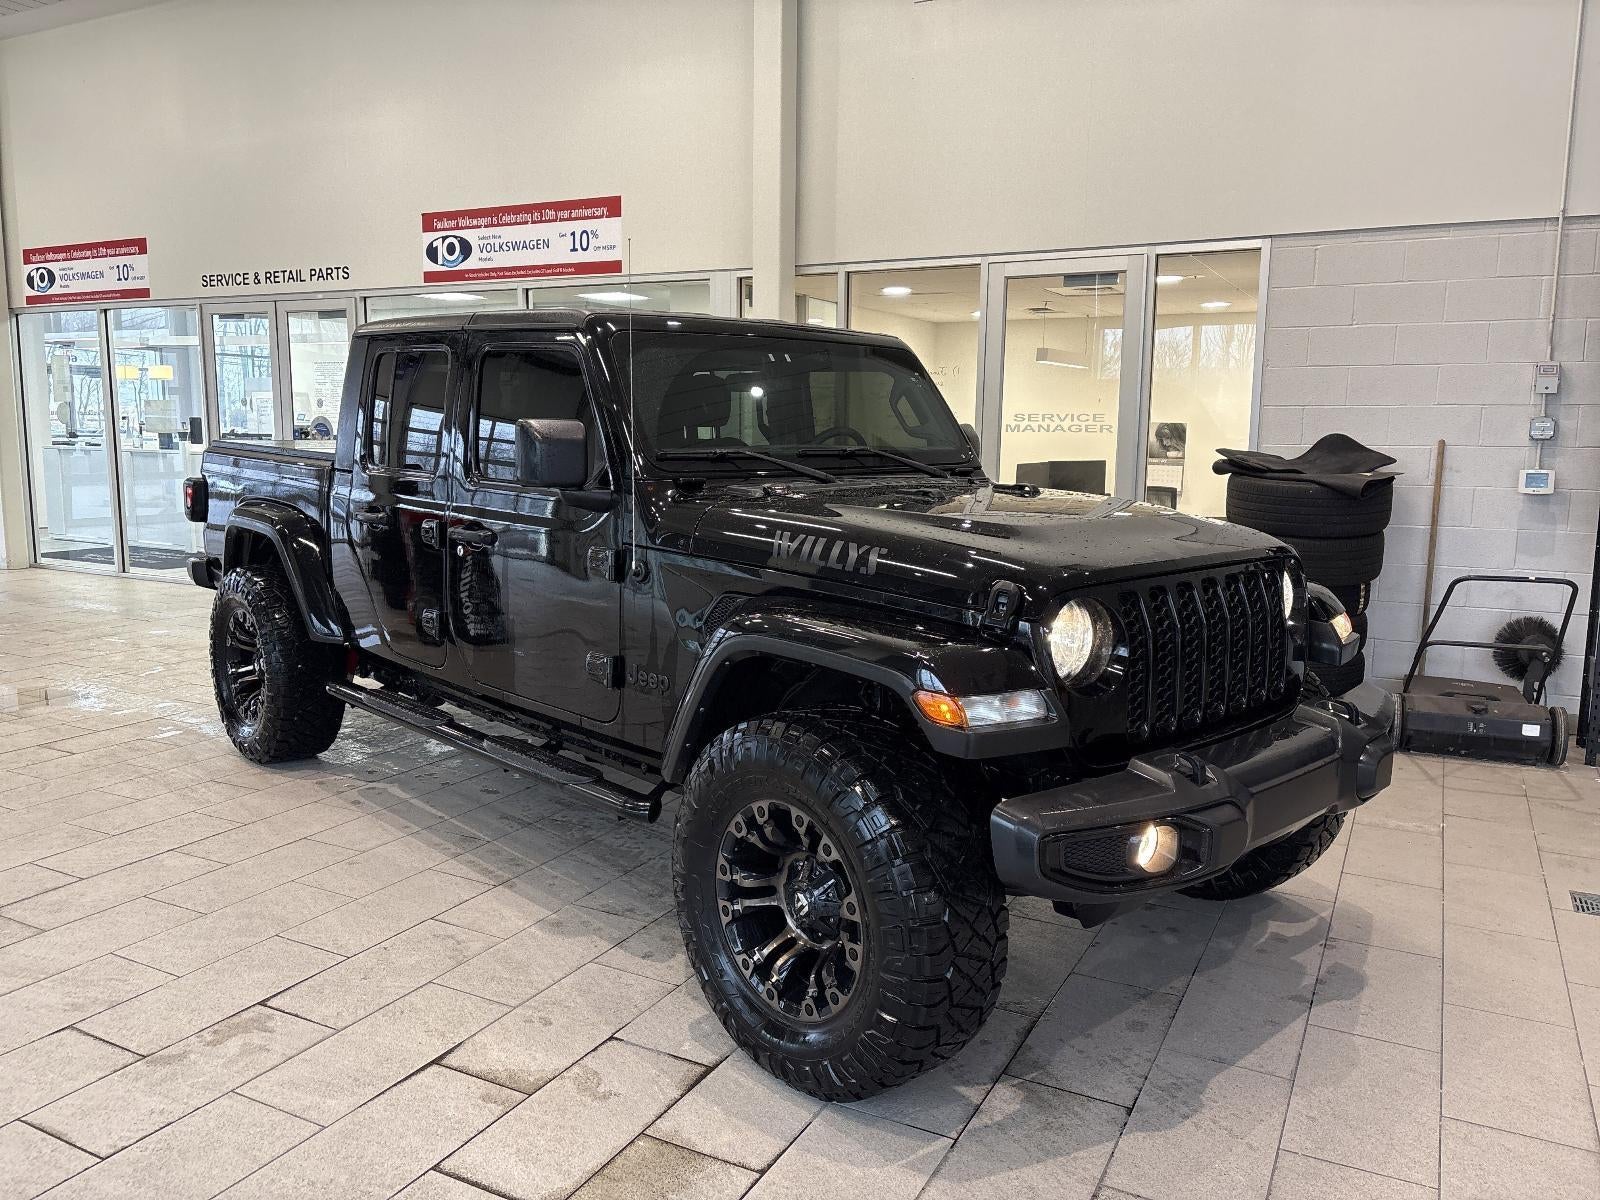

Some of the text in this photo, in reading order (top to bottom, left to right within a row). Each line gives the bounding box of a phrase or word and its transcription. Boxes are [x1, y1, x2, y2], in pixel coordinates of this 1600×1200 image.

[433, 217, 457, 229] Faulkner
[457, 215, 492, 229] Volkswagen
[492, 214, 498, 224] is
[498, 210, 532, 224] Celebrating
[541, 208, 556, 220] 10th
[556, 210, 570, 222] year
[571, 205, 609, 218] anniversary.
[478, 238, 550, 254] VOLKSWAGEN
[58, 269, 105, 282] VOLKSWAGEN
[201, 265, 350, 288] SERVICE & RETAIL PARTS
[1013, 413, 1105, 423] SERVICE
[1005, 423, 1114, 434] MANAGER
[767, 530, 889, 576] WILLYS
[626, 663, 671, 696] Jeep
